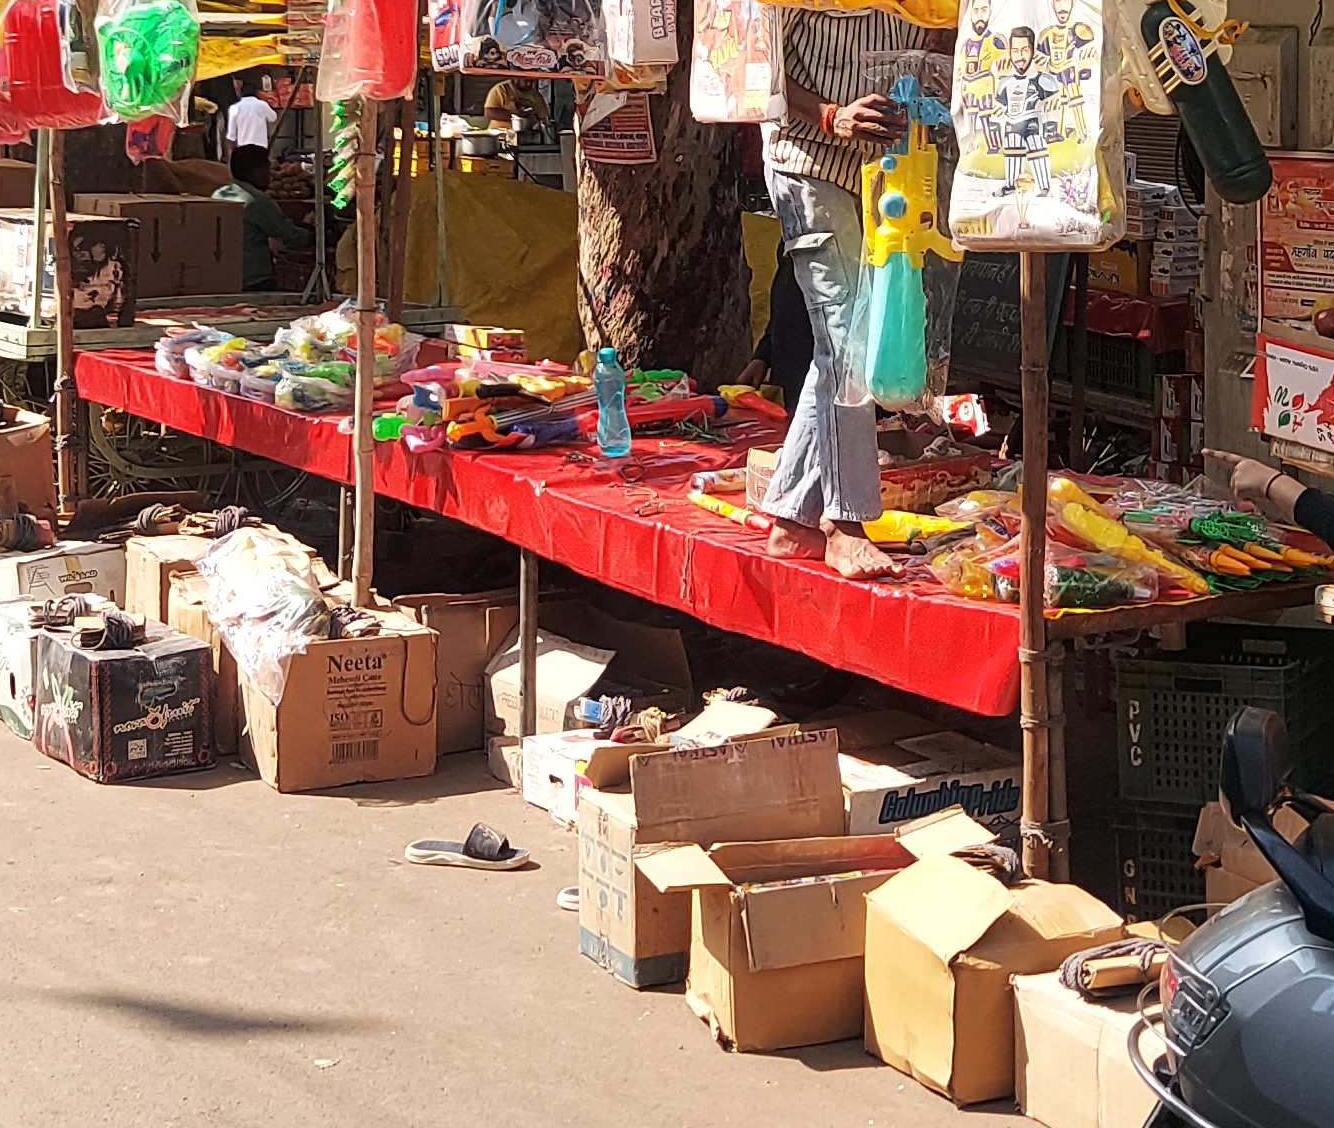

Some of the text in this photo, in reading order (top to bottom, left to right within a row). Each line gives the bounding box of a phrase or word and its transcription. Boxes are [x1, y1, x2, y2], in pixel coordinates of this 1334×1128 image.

[326, 653, 383, 674] Neeta
[329, 712, 349, 723] ISO
[1128, 699, 1143, 767] PVC
[878, 777, 1020, 824] Columbia Pride
